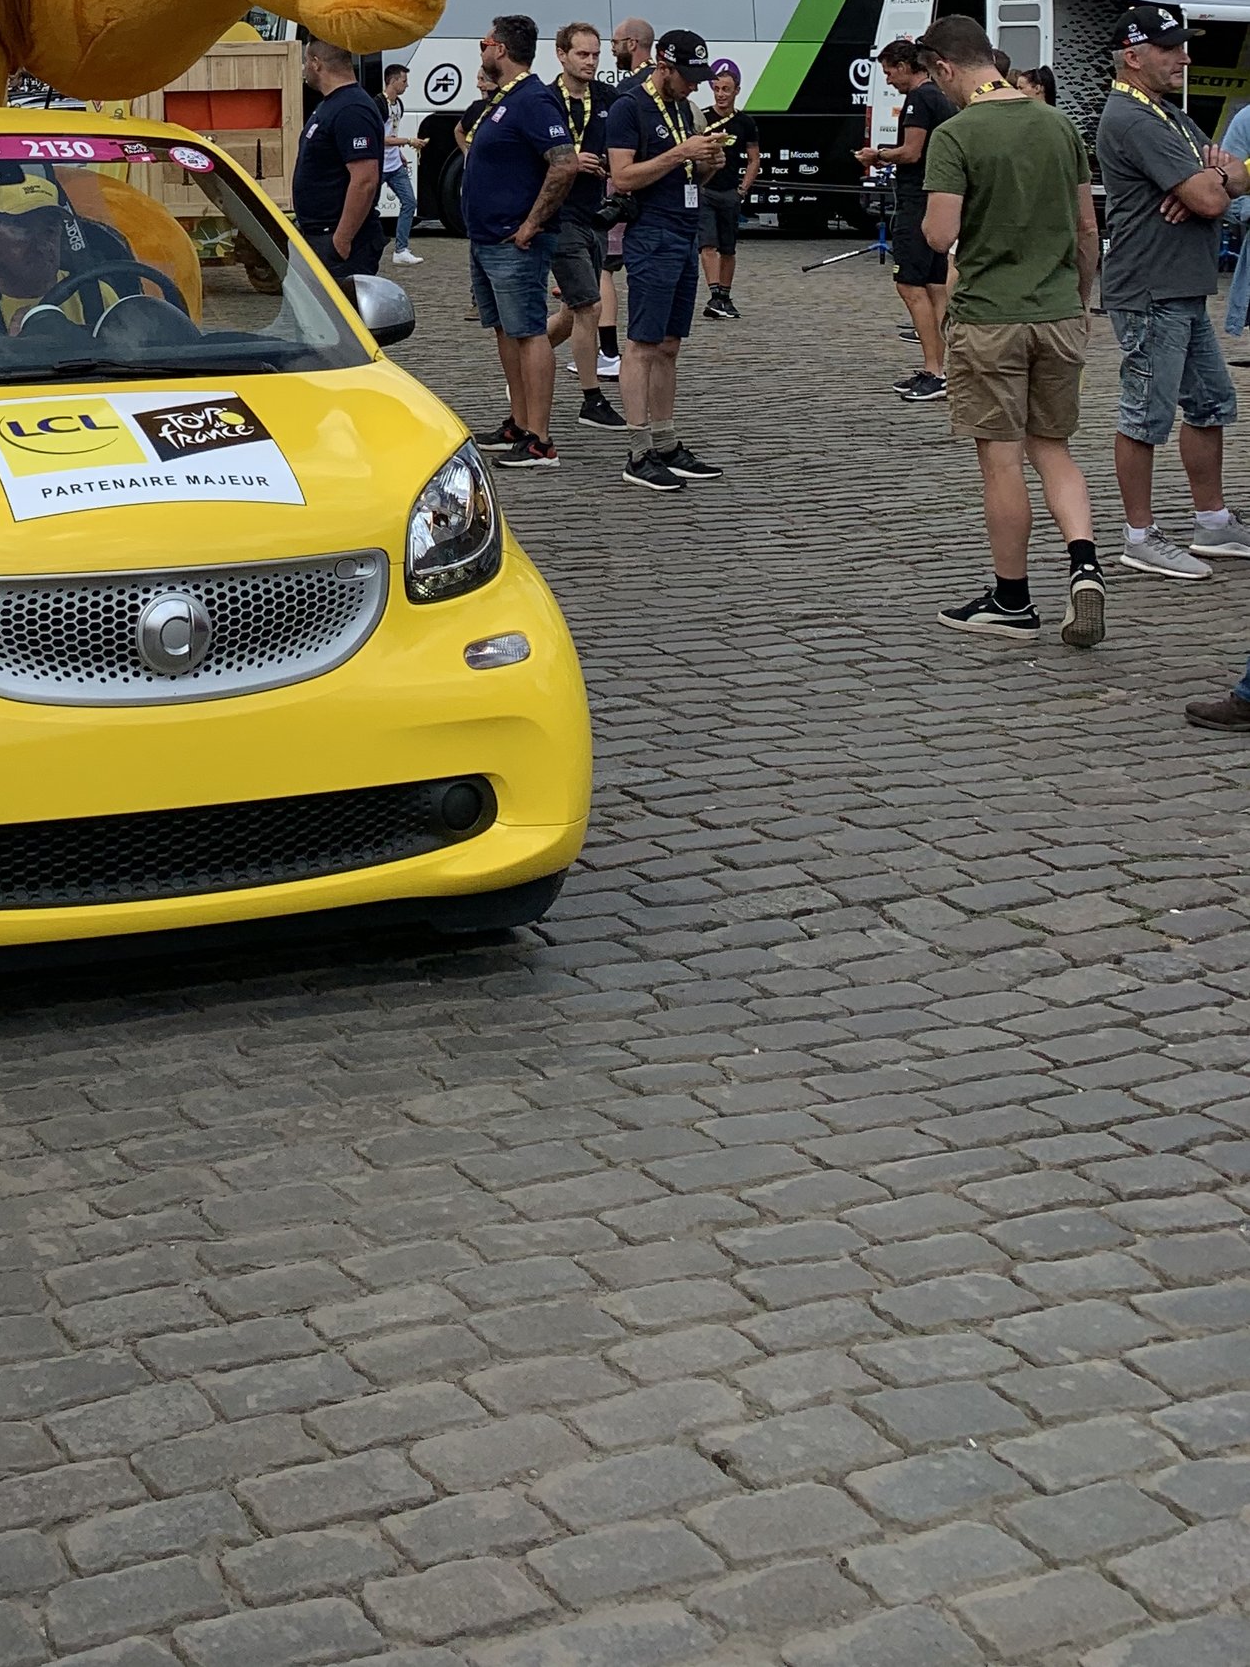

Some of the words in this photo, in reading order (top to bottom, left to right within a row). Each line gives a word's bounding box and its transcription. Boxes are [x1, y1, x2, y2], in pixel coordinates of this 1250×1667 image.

[1189, 75, 1248, 88] SCOTT
[21, 140, 95, 159] 2130
[790, 150, 819, 159] Microsoft
[6, 414, 119, 438] LCL
[41, 475, 178, 499] PARTENAIRE
[186, 475, 271, 488] MAJEUR
